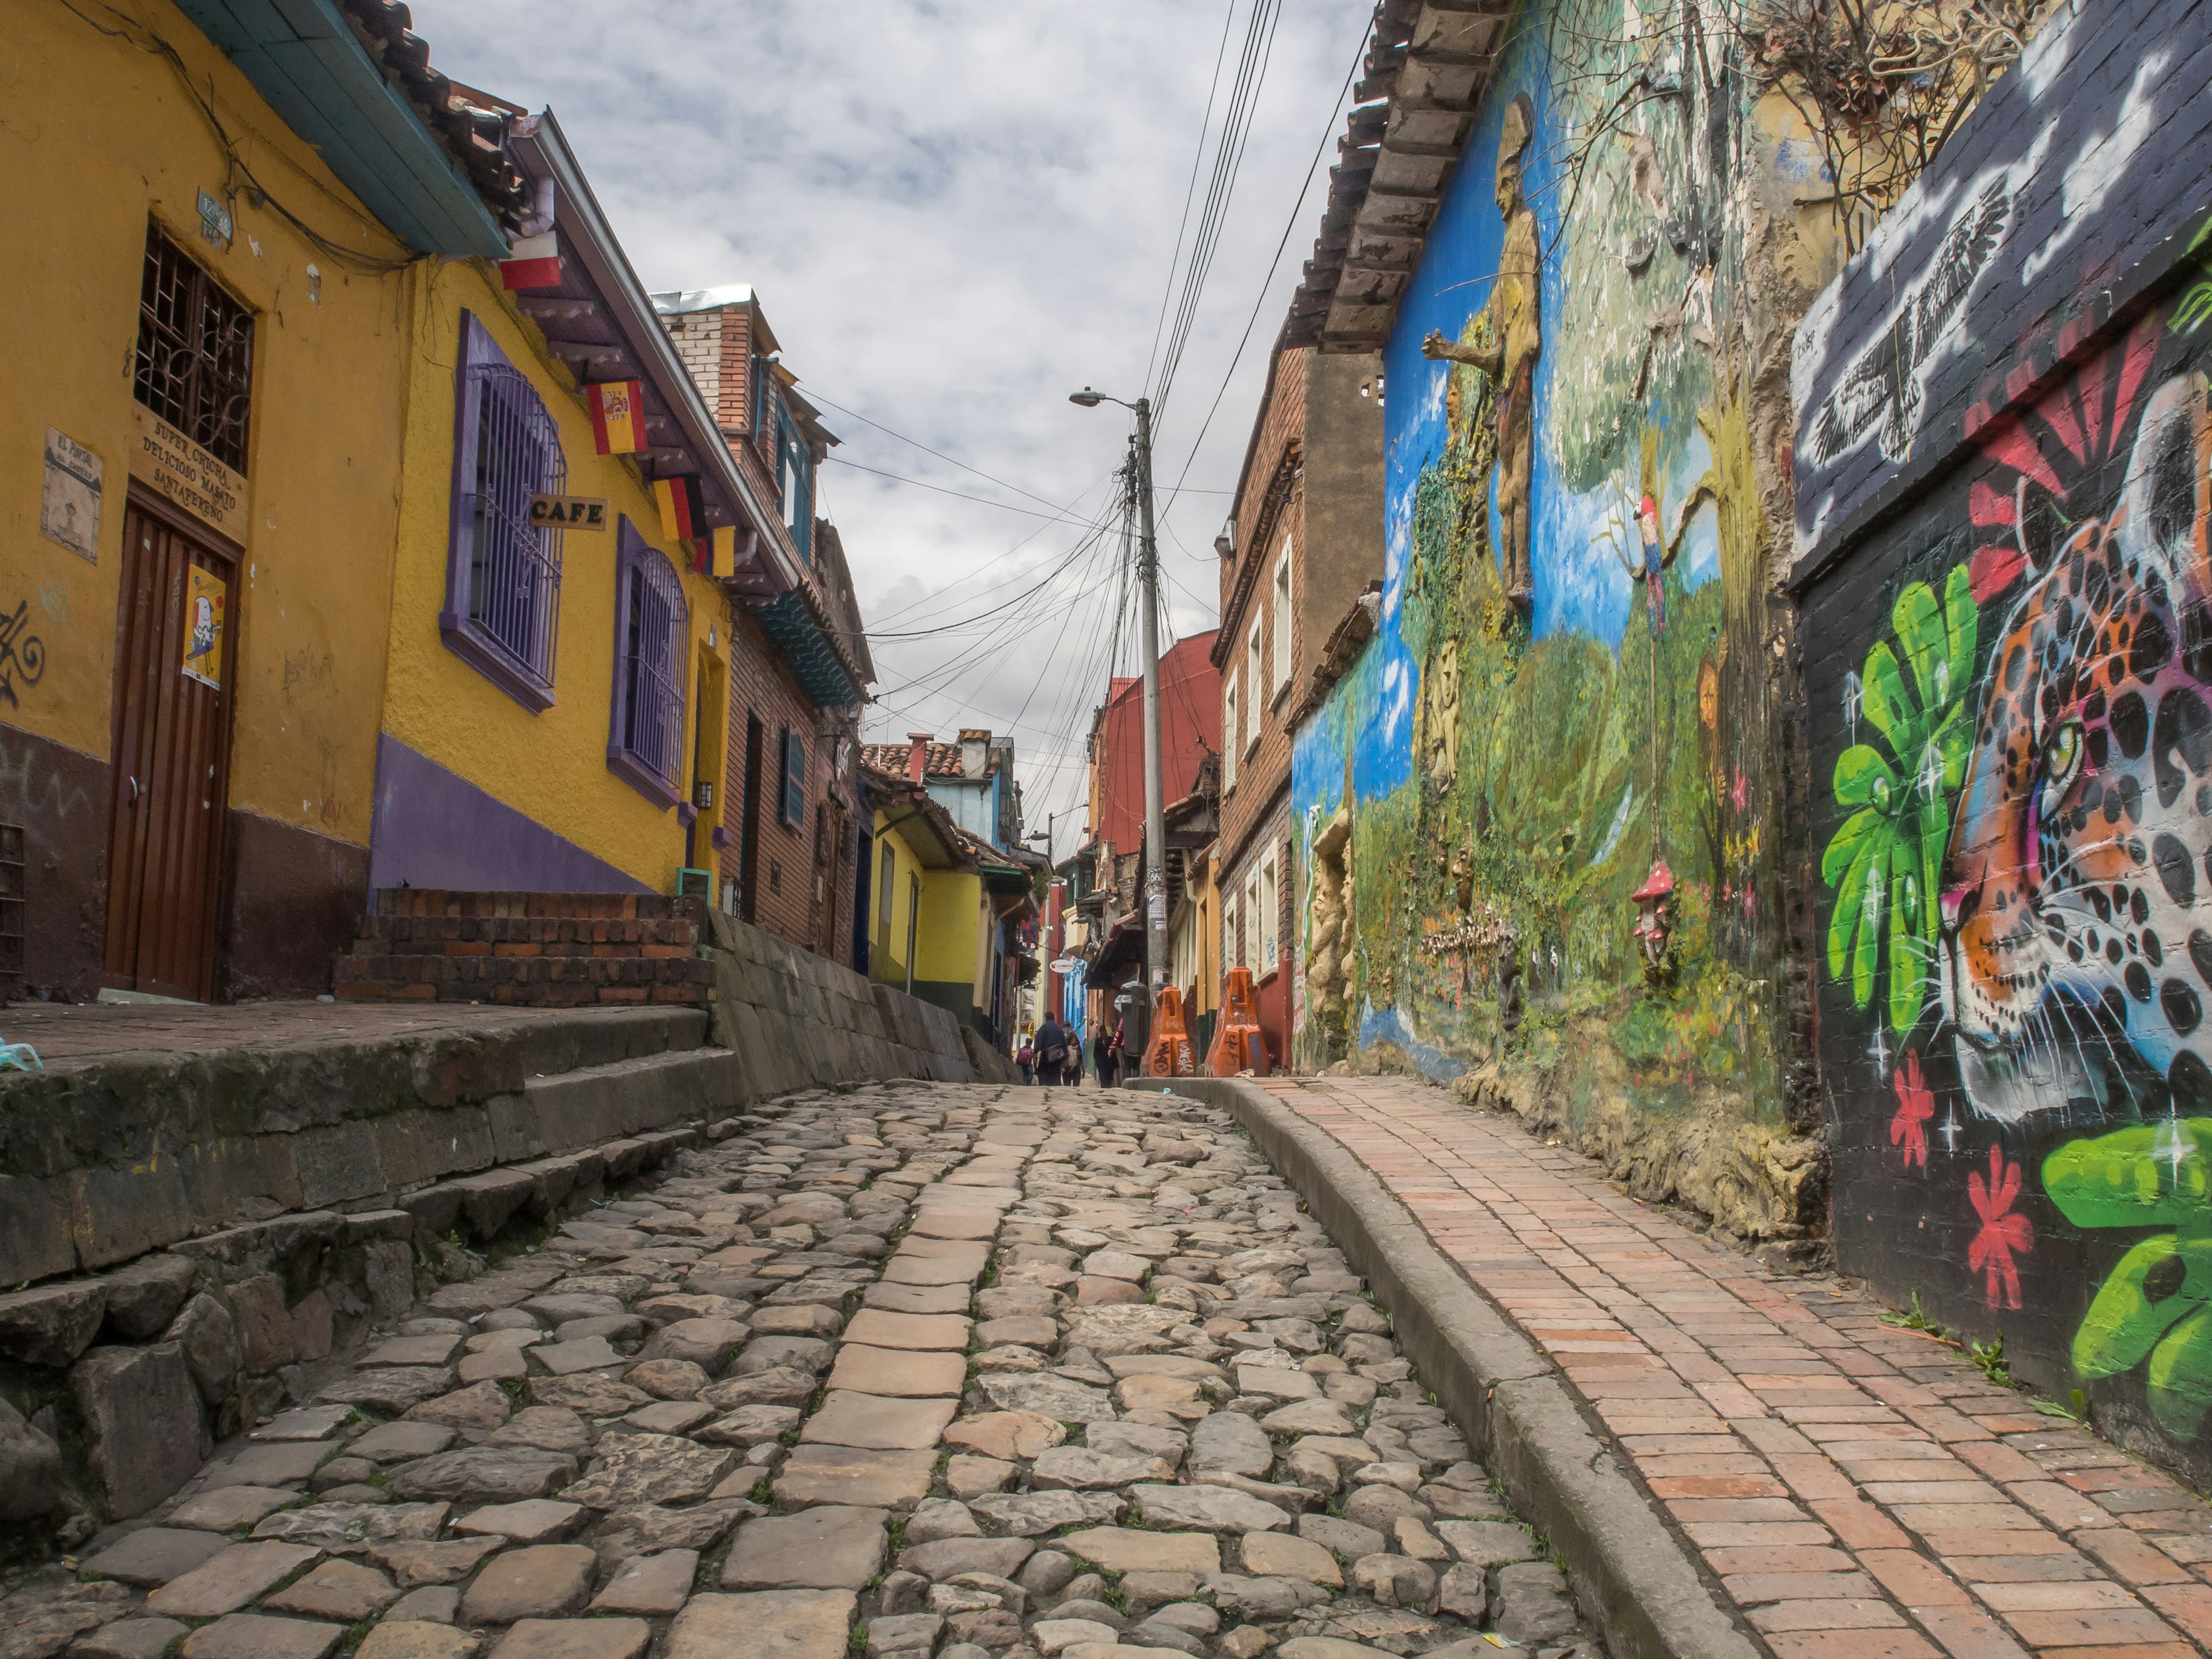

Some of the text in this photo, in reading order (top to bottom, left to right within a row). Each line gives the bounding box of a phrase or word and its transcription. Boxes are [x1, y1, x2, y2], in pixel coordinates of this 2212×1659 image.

[142, 436, 236, 511] DELICIOSO MASATO
[155, 422, 231, 490] SUPER CHICHA
[531, 501, 603, 524] CAFE
